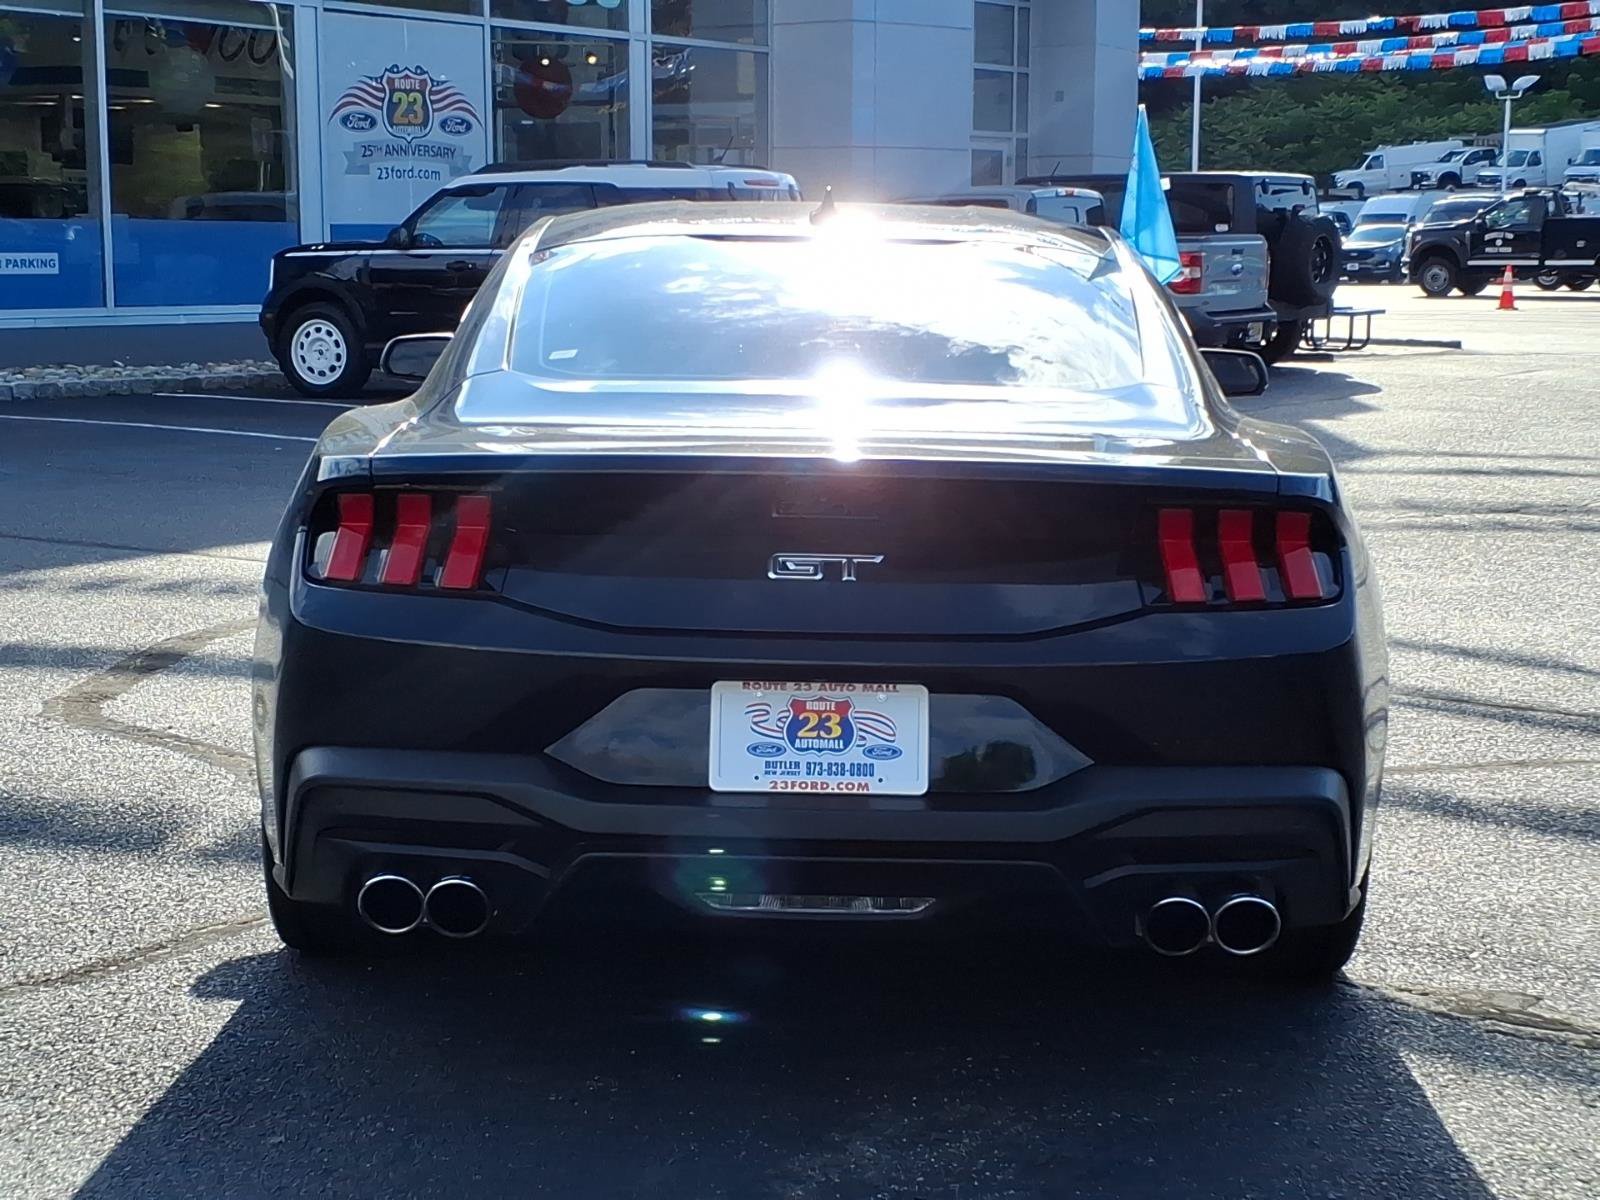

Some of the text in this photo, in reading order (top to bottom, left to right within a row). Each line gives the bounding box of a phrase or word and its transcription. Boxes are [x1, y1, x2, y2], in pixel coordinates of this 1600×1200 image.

[394, 79, 421, 90] ROUTE
[393, 92, 423, 124] 23
[346, 114, 371, 130] Ford
[444, 118, 466, 133] Ford
[384, 145, 457, 160] ANNIVERSARY
[376, 166, 441, 181] 23ford.com
[5, 258, 56, 269] PARKING
[767, 552, 884, 582] GT
[742, 682, 787, 691] ROUTE
[818, 683, 856, 692] AUTO
[862, 684, 899, 693] MALL
[806, 701, 836, 711] ROUTE
[797, 712, 842, 738] 23
[794, 738, 844, 749] AUTOMALL
[764, 760, 875, 777] BUTLER 973-838-0800
[769, 780, 870, 791] 23FORD.COM
